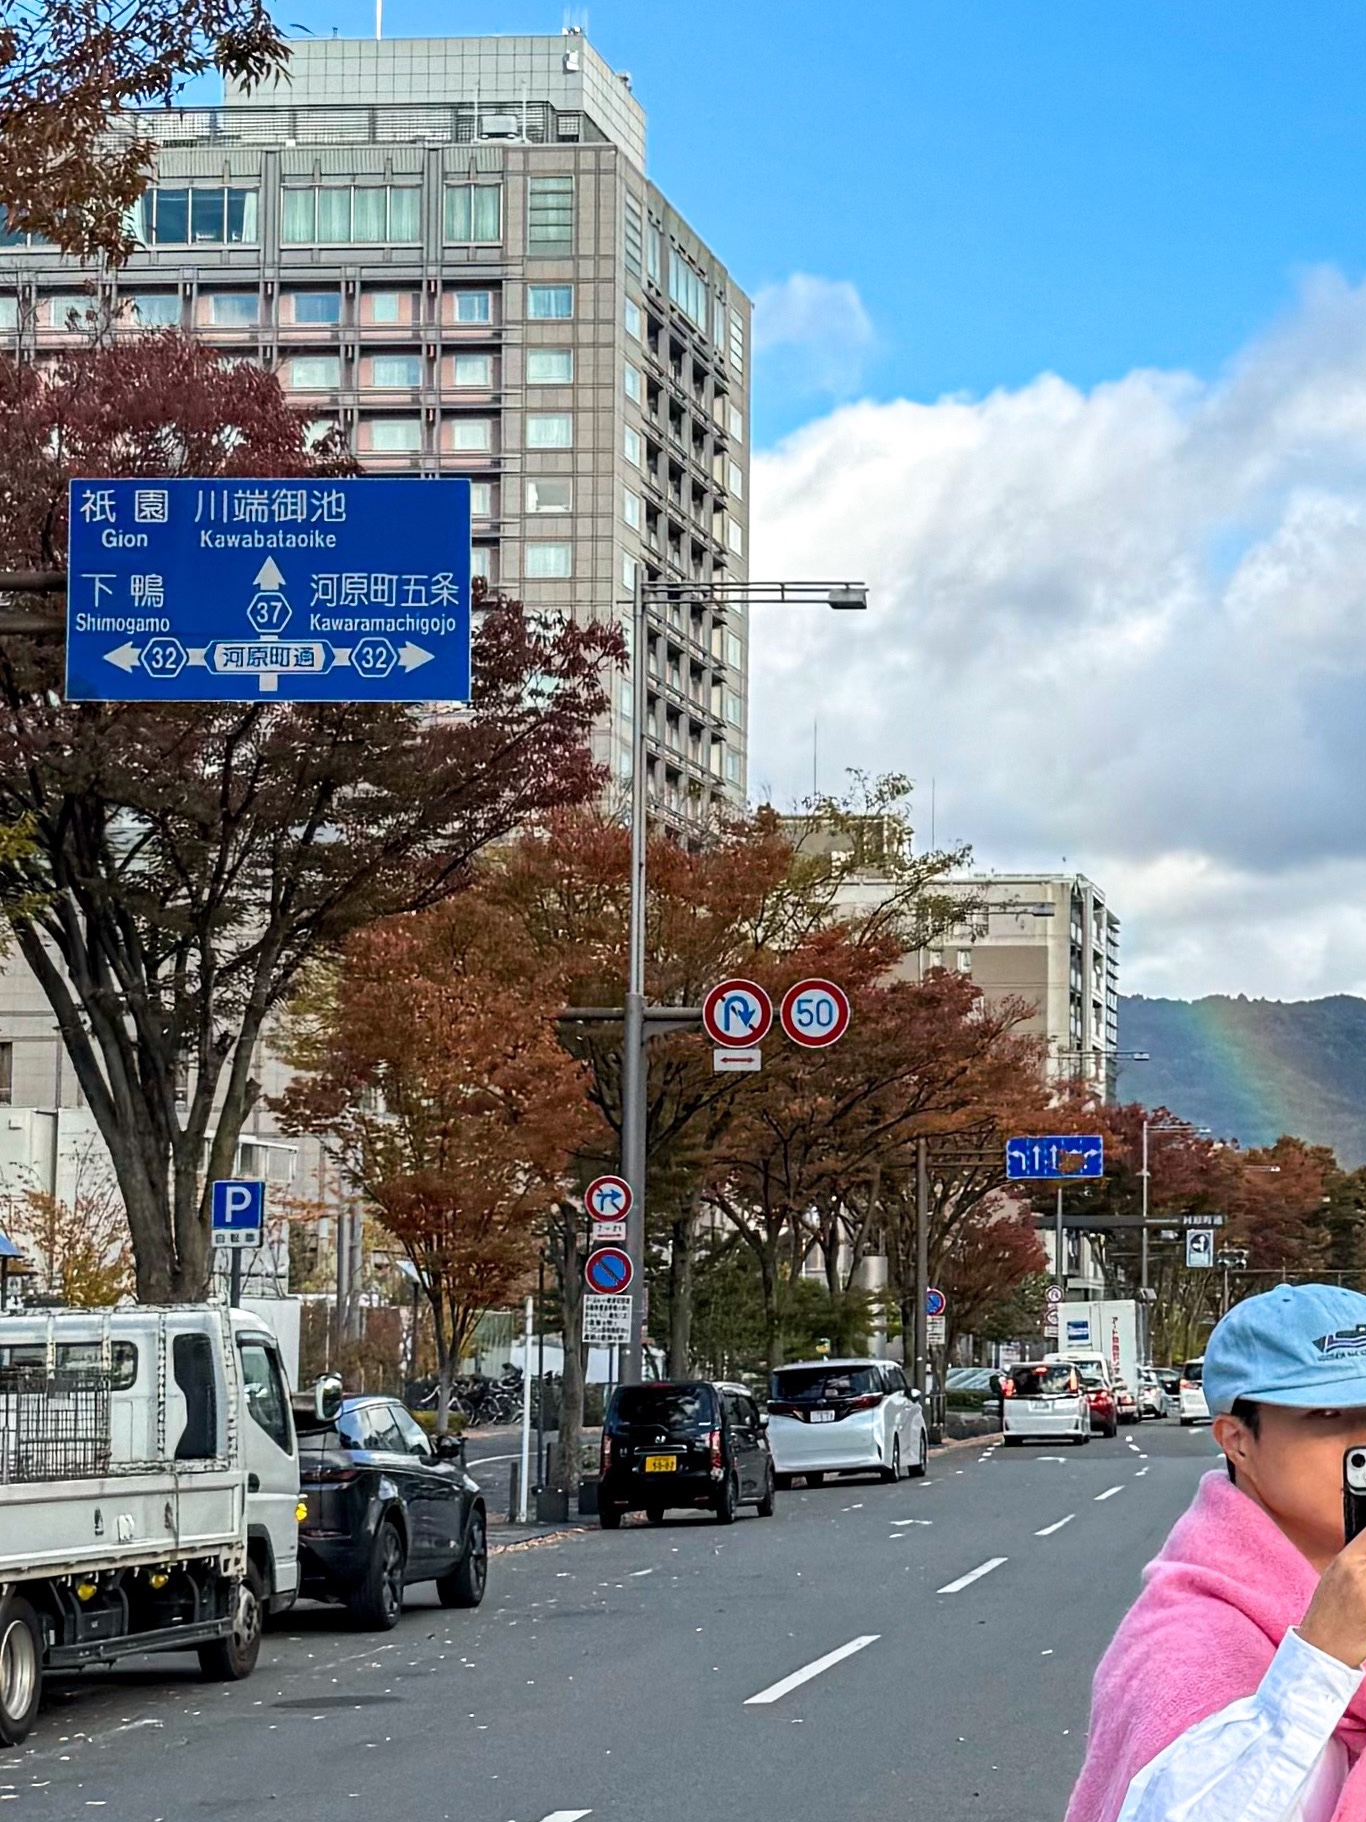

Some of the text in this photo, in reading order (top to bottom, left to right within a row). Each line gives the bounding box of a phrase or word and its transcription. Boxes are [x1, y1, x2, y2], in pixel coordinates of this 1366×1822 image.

[79, 489, 346, 524] 祇園 川端御池
[101, 529, 336, 549] Gion Kawabataoike
[80, 573, 165, 608] 下鴨
[310, 572, 460, 608] 河原町五条
[256, 602, 283, 623] 37
[75, 613, 170, 635] Shimogamo
[309, 613, 456, 635] Kawaramachigojo
[151, 647, 178, 669] 32
[222, 647, 315, 668] 河原町通
[361, 647, 388, 669] 32
[796, 998, 834, 1027] 50
[225, 1186, 252, 1223] P
